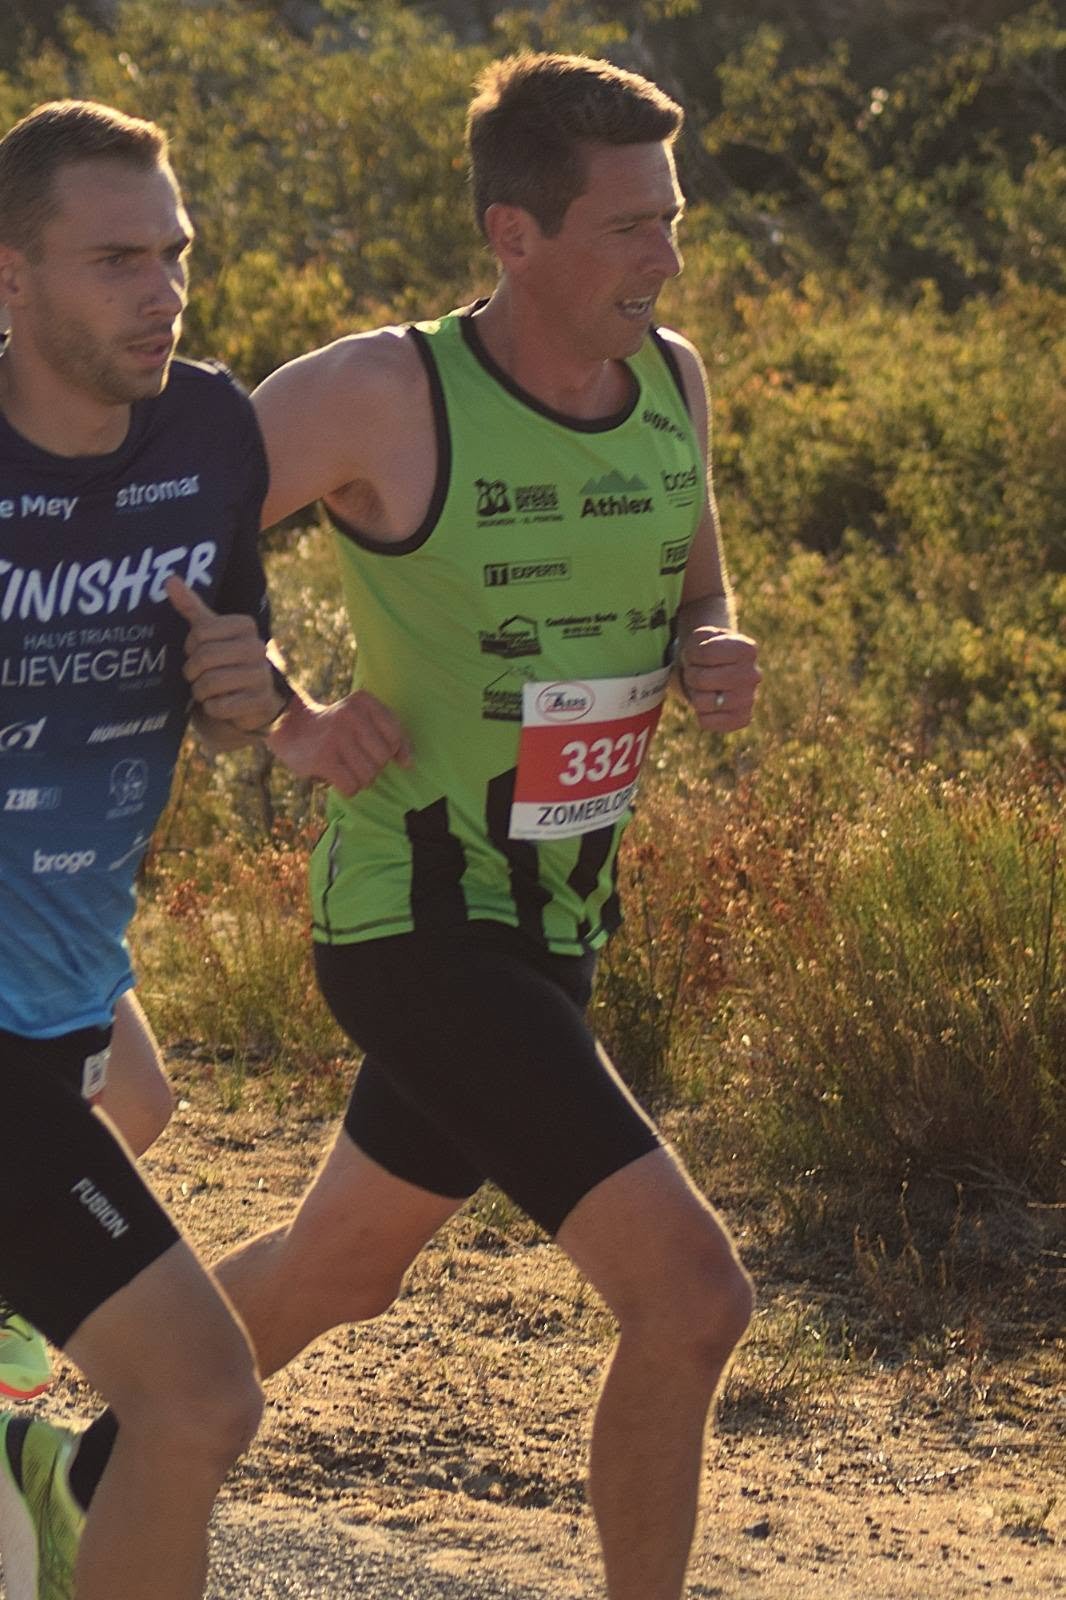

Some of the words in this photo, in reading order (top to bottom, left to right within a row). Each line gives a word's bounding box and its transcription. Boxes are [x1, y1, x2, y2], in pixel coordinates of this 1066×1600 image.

[21, 494, 79, 521] Mey
[580, 496, 653, 519] Athlex
[0, 541, 217, 624] INISHER
[510, 562, 568, 580] EXPERTS
[24, 628, 77, 651] HALVE
[80, 623, 156, 647] TRIATLON
[1, 645, 167, 688] LIEVEGEM
[558, 727, 650, 787] 3321
[70, 1176, 129, 1239] FUSION
